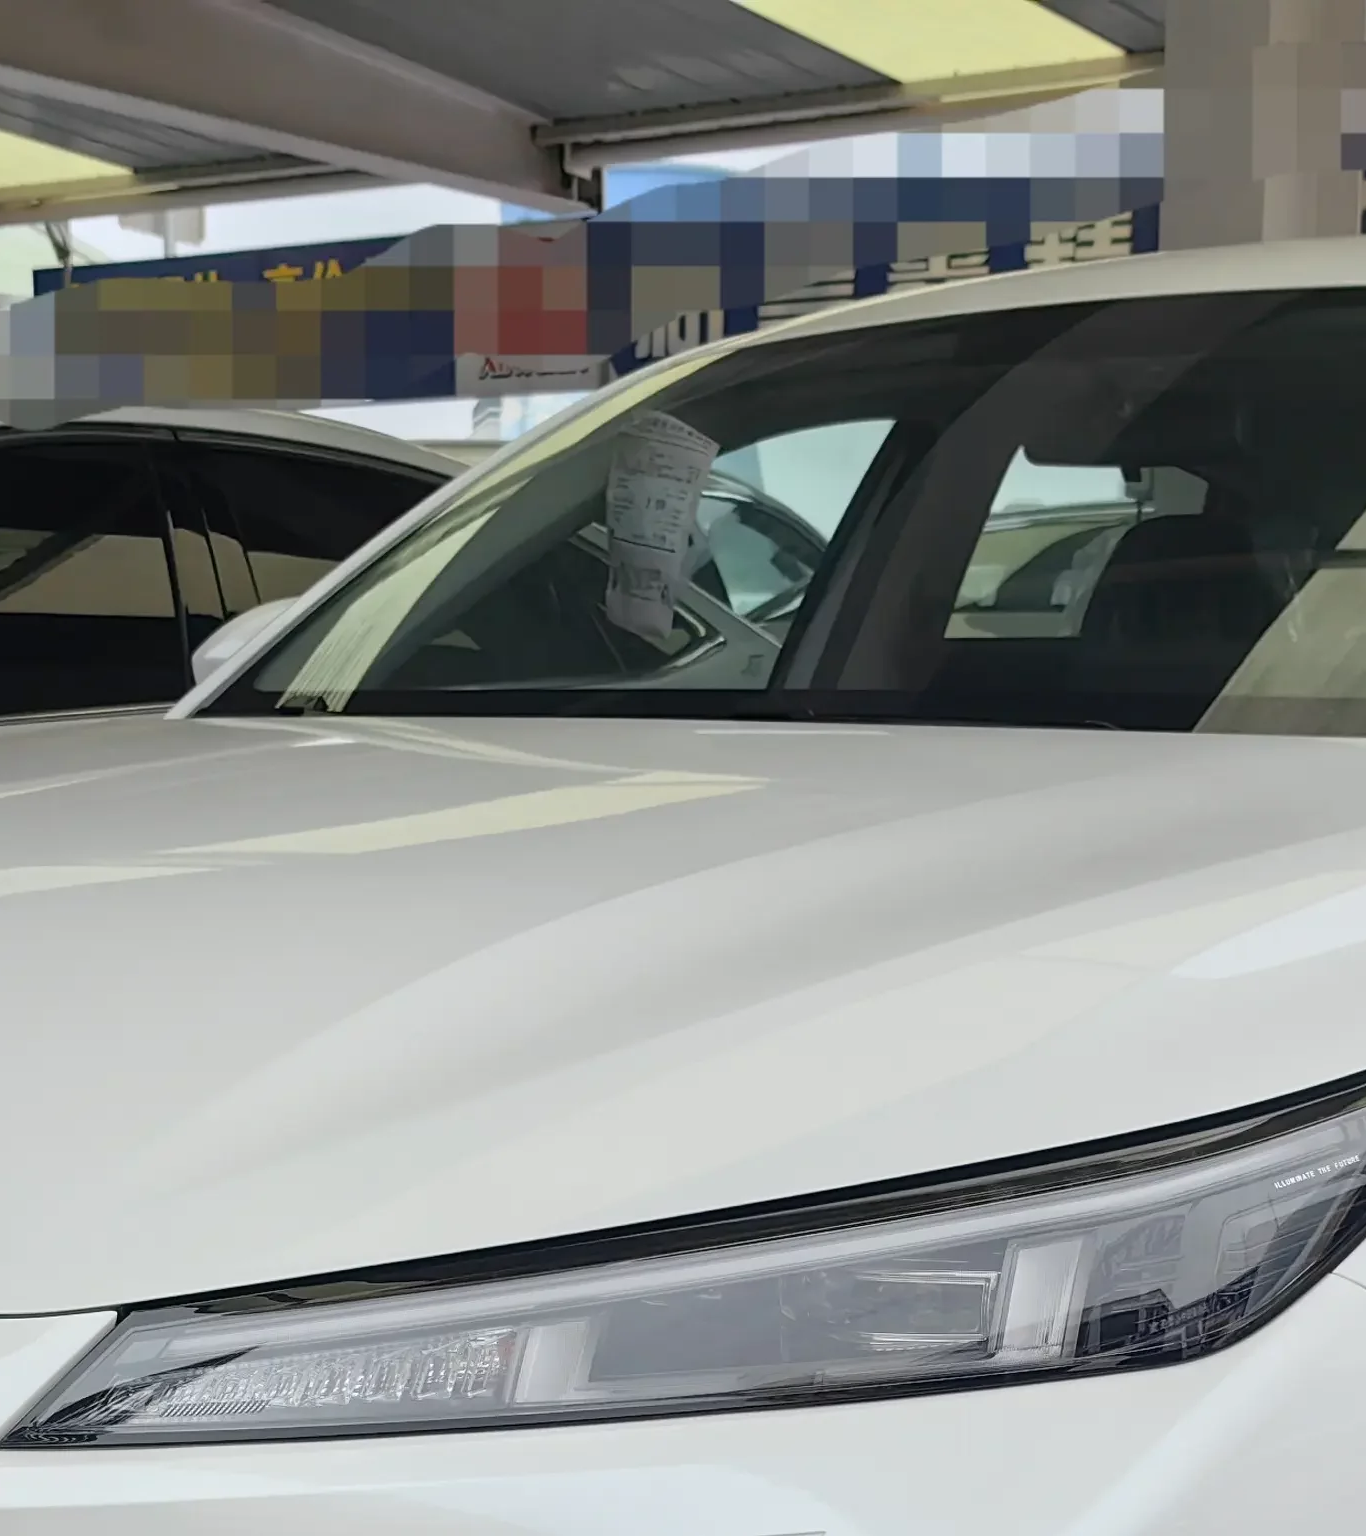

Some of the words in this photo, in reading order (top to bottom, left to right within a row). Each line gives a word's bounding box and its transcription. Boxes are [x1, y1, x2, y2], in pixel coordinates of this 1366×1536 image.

[1273, 1170, 1315, 1189] ILLUMINATE
[1317, 1164, 1332, 1176] THE
[1334, 1154, 1360, 1169] FUTURE
